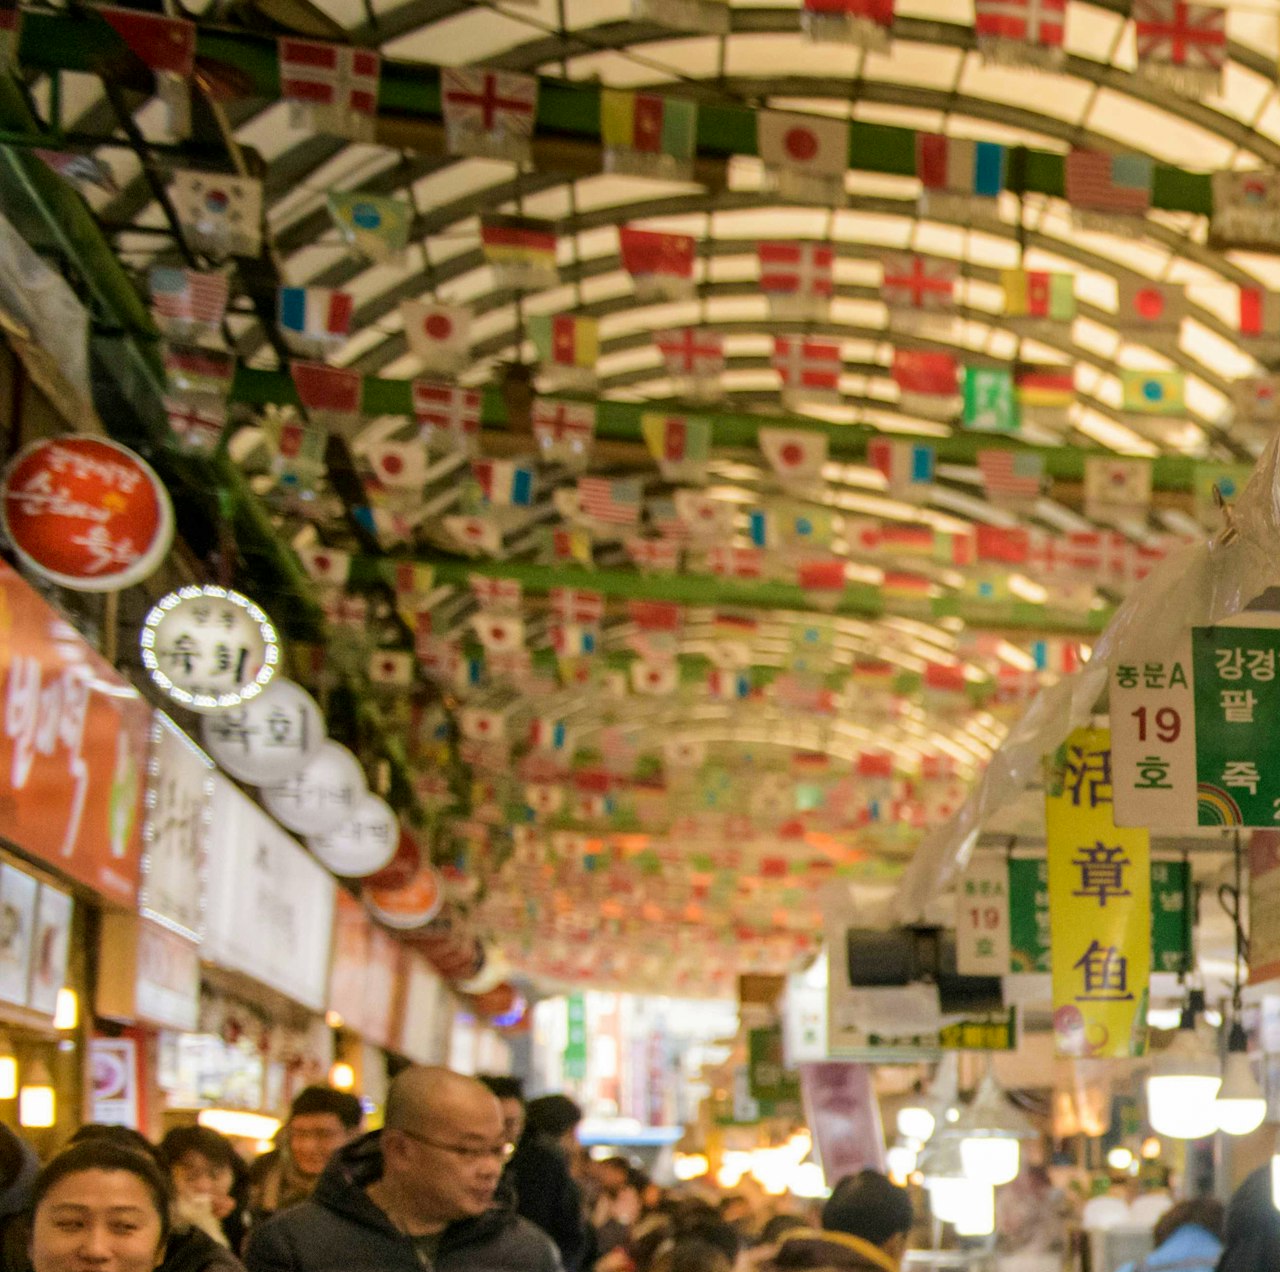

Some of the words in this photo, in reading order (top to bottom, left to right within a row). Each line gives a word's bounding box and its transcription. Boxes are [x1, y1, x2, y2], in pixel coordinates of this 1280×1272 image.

[1116, 662, 1188, 689] 동문A
[1131, 706, 1182, 743] 19
[1134, 756, 1173, 789] 호
